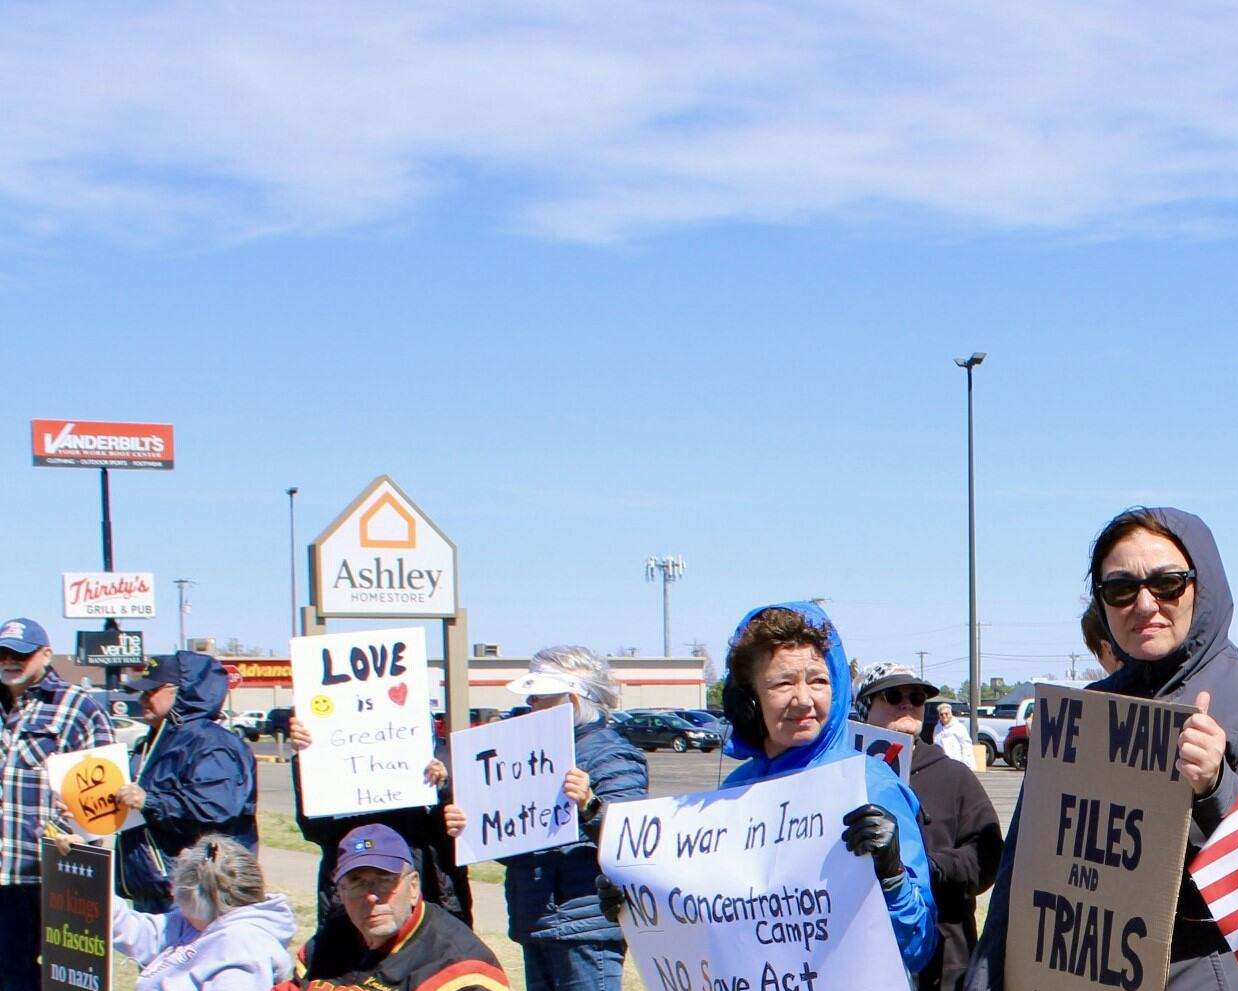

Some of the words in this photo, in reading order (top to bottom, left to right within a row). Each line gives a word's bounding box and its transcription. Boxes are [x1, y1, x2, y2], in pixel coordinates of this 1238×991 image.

[44, 422, 165, 455] VANDERBILT'S
[70, 576, 150, 605] Thirsty's
[333, 557, 442, 598] Ashley
[86, 605, 116, 614] GRILL
[120, 605, 128, 614] &
[131, 605, 153, 614] PUB
[351, 592, 425, 603] HOMESTORE
[101, 645, 142, 656] venue
[118, 632, 142, 646] the
[321, 642, 407, 685] LOVE
[356, 694, 374, 712] is
[330, 721, 420, 747] Greater
[1040, 697, 1083, 763] WE
[1108, 700, 1189, 781] WANT
[76, 765, 106, 790] NO
[344, 755, 409, 774] Than
[357, 787, 404, 805] Hate
[482, 801, 572, 845] Matters
[616, 815, 662, 860] NO
[677, 827, 727, 858] war
[744, 817, 766, 850] in
[774, 801, 823, 844] Iran
[1055, 793, 1143, 871] FILES
[1068, 862, 1099, 892] AND
[622, 884, 658, 928] NO
[668, 885, 832, 925] Concentration
[46, 926, 60, 946] no
[63, 923, 106, 957] fascists
[1033, 890, 1148, 991] TRIALS
[51, 963, 67, 982] no
[68, 966, 100, 991] nazis
